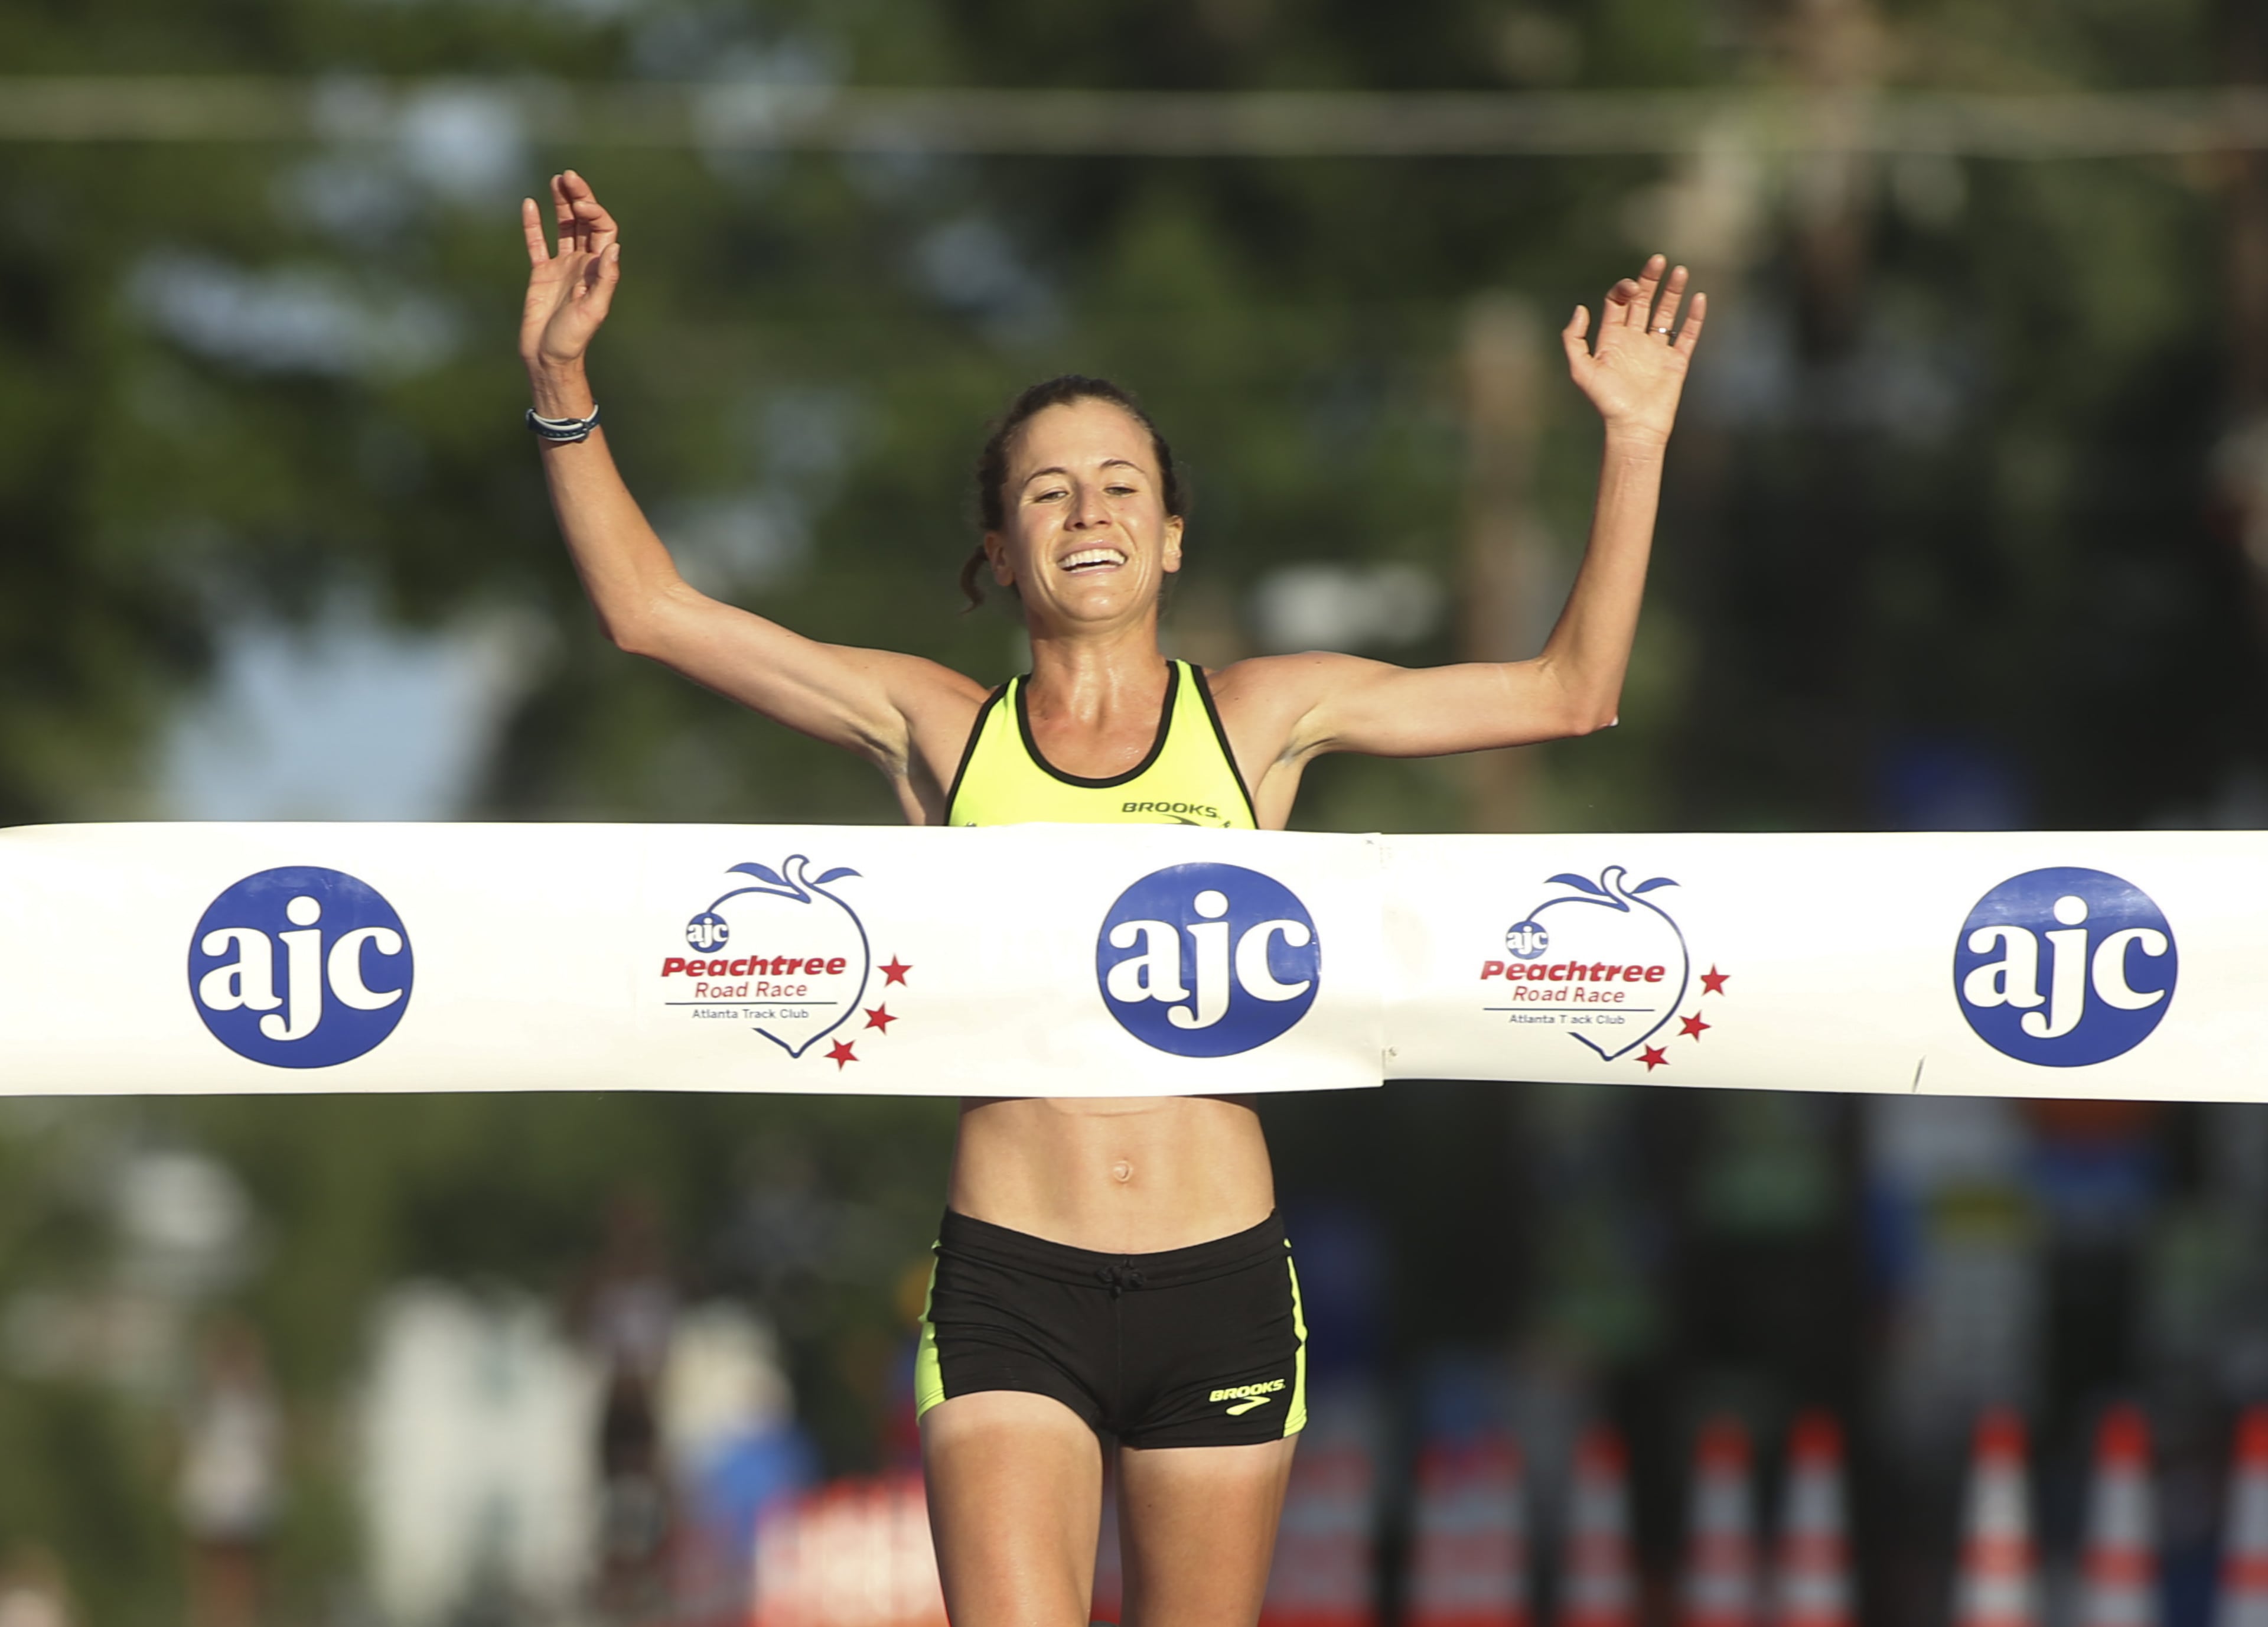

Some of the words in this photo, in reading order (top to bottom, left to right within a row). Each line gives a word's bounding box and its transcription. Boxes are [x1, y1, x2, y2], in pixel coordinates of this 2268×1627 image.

[1122, 802, 1218, 818] BROOKS
[686, 917, 729, 949] ajc
[1506, 925, 1549, 955] ajc
[198, 895, 403, 1042] ajc
[660, 955, 846, 977] Peachtree
[1106, 889, 1312, 1030] ajc
[1963, 894, 2169, 1039] ajc
[1480, 961, 1666, 982] Peachtree
[695, 981, 749, 998] Road
[756, 981, 807, 997] Race
[1512, 985, 1568, 1001] Road
[1572, 987, 1625, 1003] Race
[692, 1009, 738, 1019] Atlanta
[742, 1009, 777, 1019] Track
[779, 1009, 810, 1019] Club
[1508, 1014, 1556, 1024] Atlanta
[1596, 1014, 1625, 1025] Club
[1209, 1378, 1285, 1402] BROOKS
